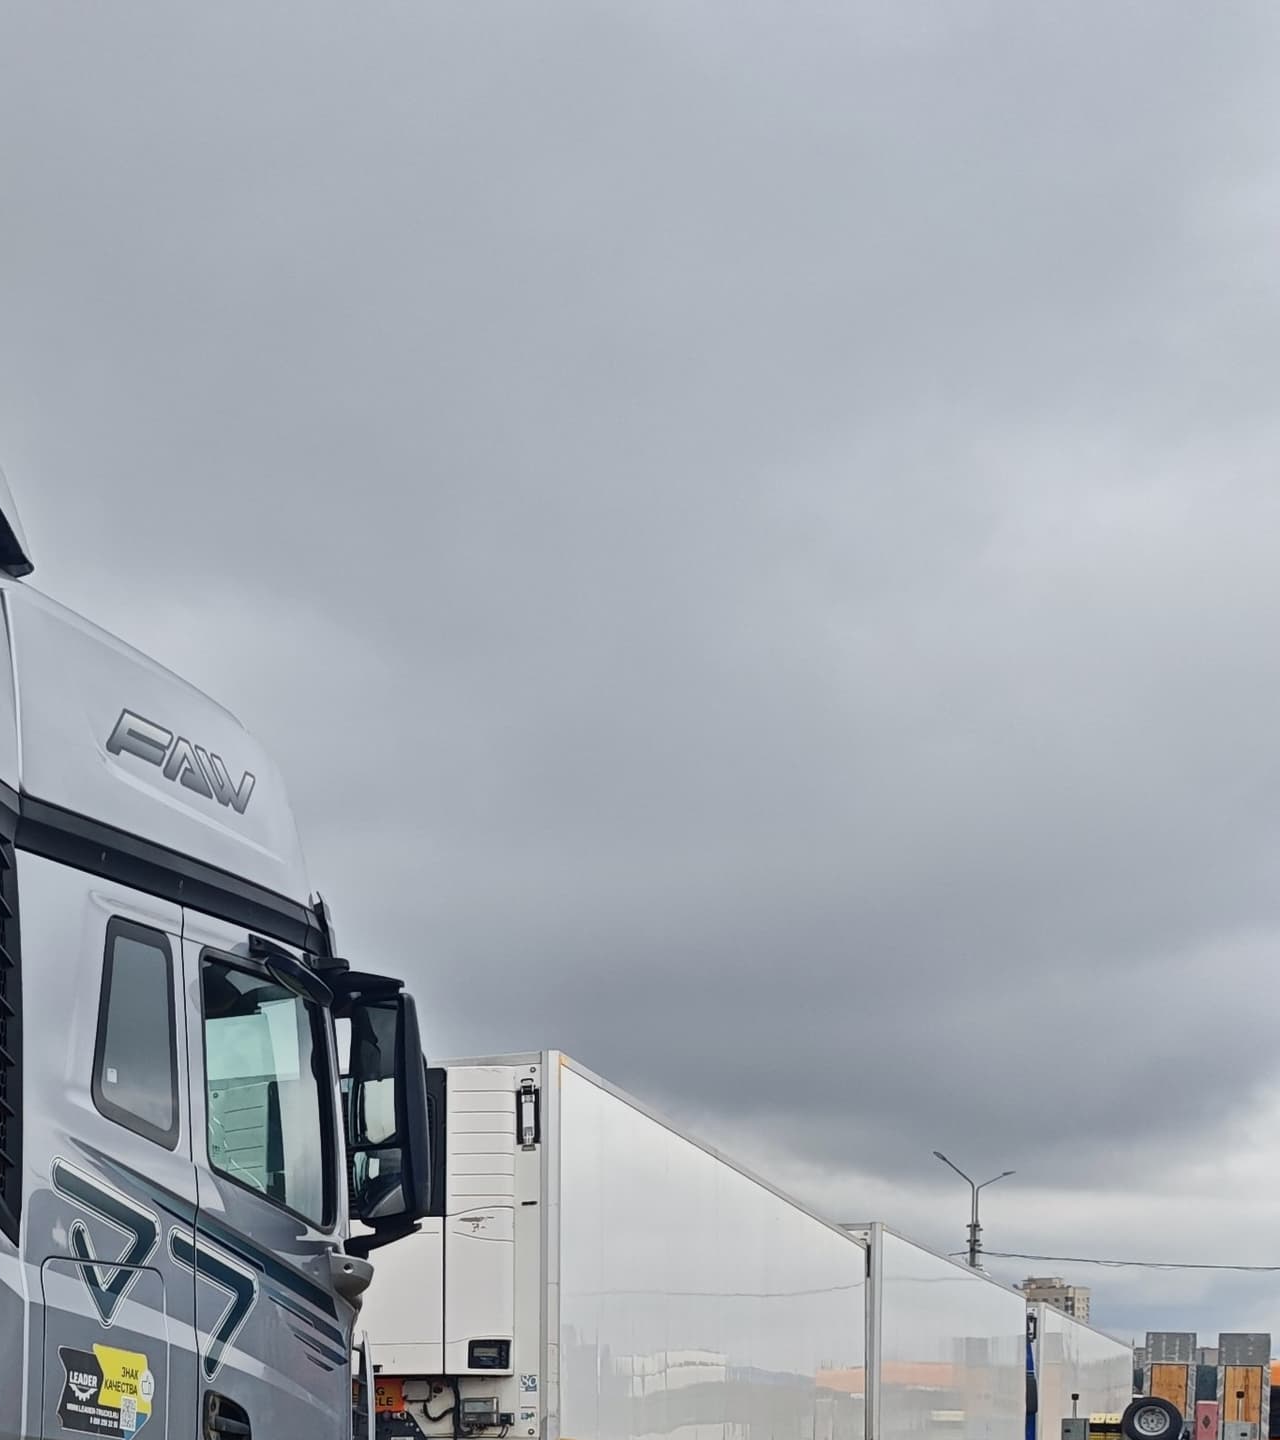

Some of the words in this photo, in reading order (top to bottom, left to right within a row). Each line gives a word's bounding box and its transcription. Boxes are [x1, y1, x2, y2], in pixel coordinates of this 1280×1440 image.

[106, 708, 256, 815] FAW
[69, 1370, 98, 1388] LEADER
[121, 1366, 139, 1380] ЗНАК
[104, 1378, 138, 1395] КАЧЕСТВА
